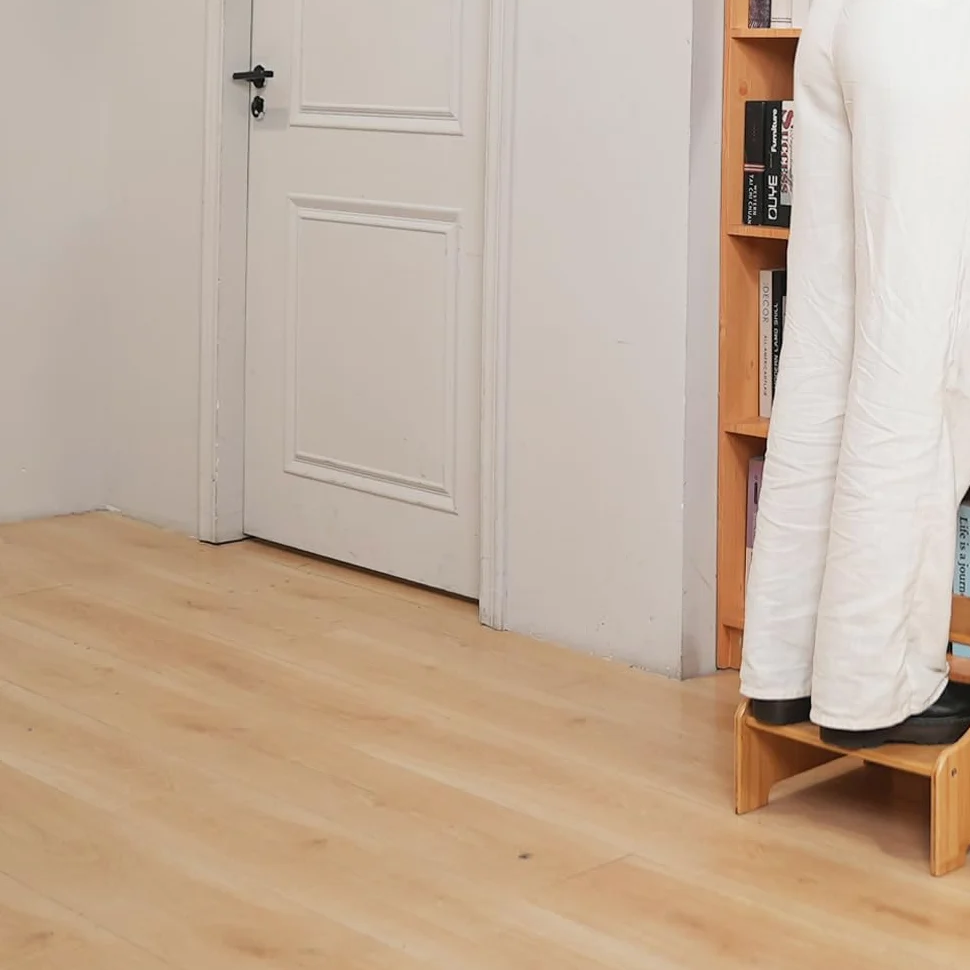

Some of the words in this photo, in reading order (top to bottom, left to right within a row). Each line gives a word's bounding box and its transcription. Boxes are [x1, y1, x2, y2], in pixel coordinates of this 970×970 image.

[770, 108, 778, 153] Furniture
[959, 516, 970, 539] Life
[959, 541, 970, 551] is
[957, 561, 970, 596] journ
